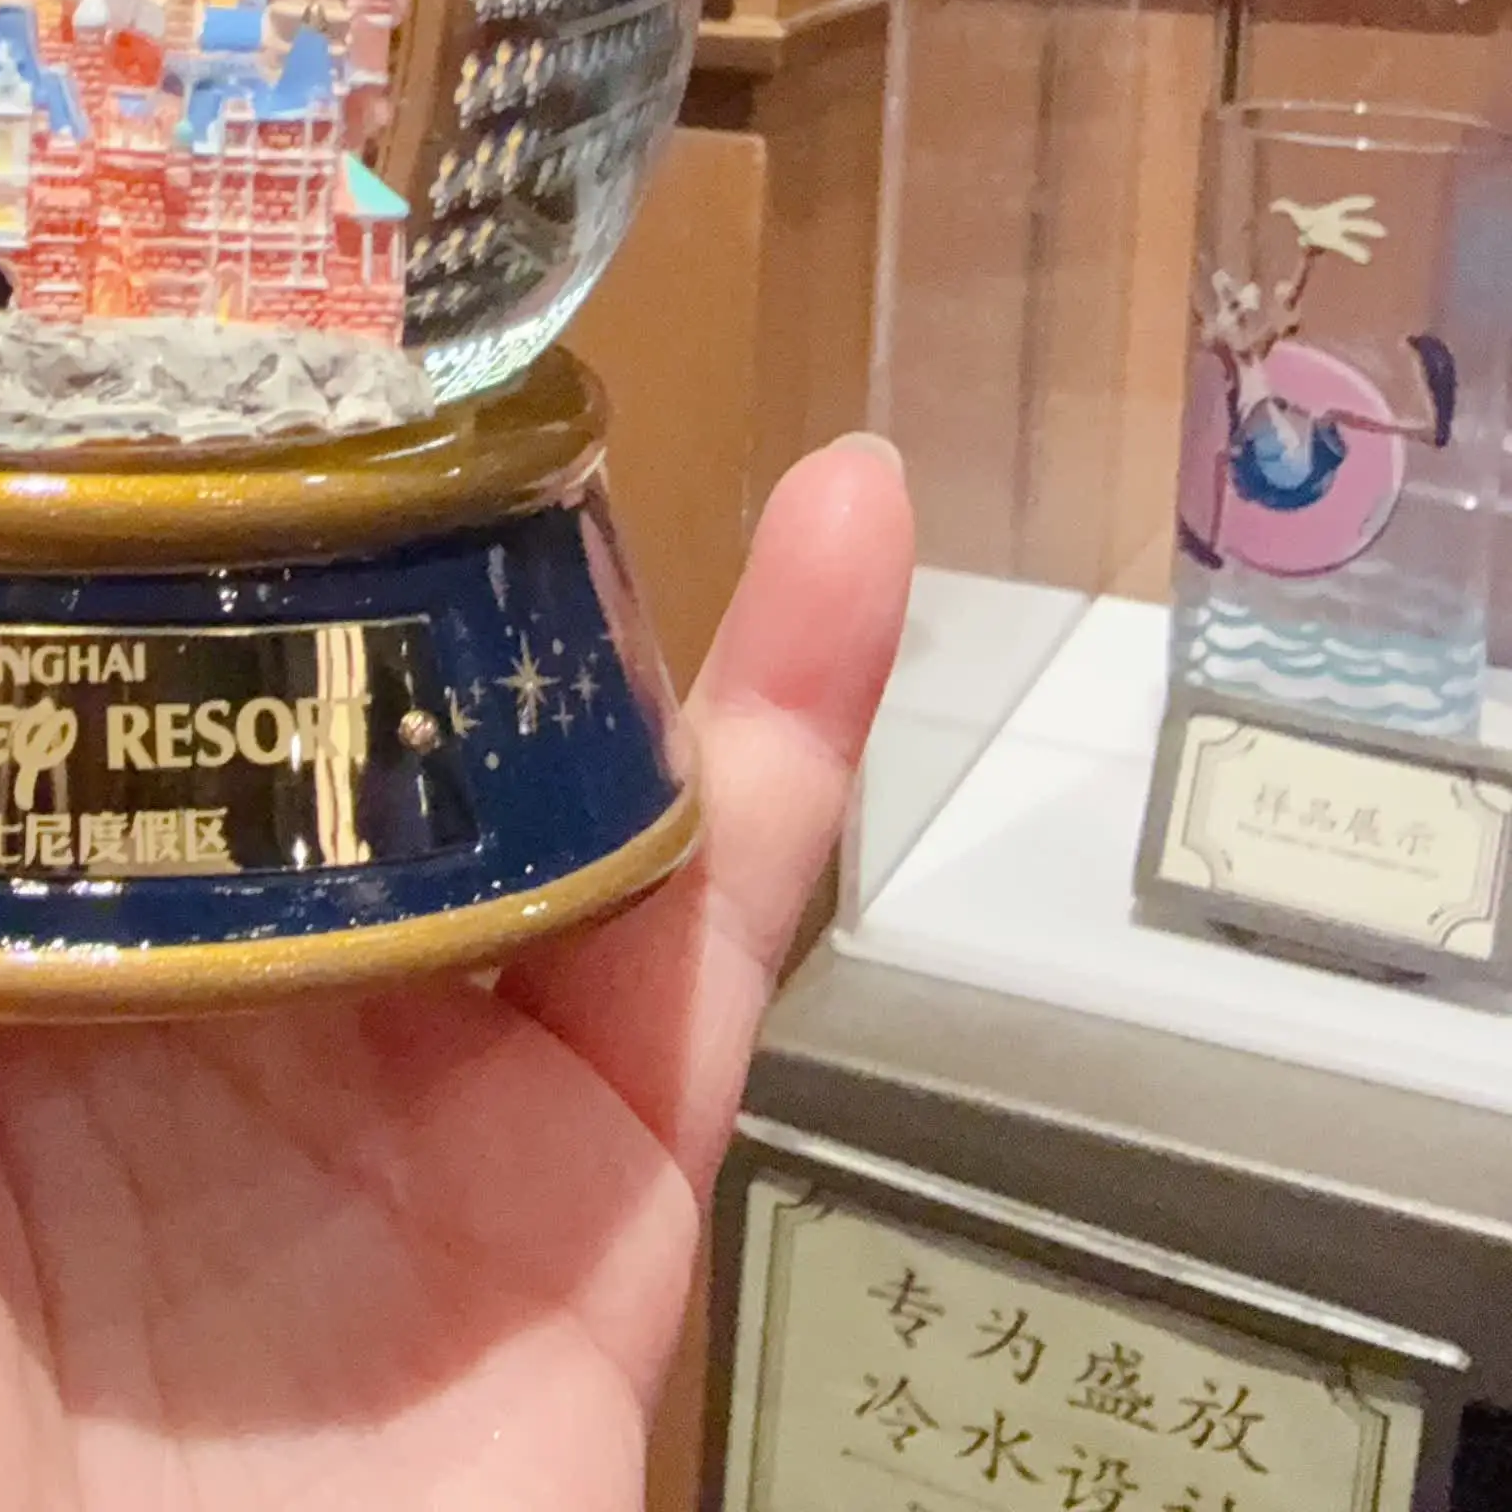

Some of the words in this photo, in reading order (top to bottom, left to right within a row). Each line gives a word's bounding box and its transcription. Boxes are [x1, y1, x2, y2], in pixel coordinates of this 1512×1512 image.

[106, 694, 372, 771] RESORT
[864, 1266, 1269, 1476] 专为盛放
